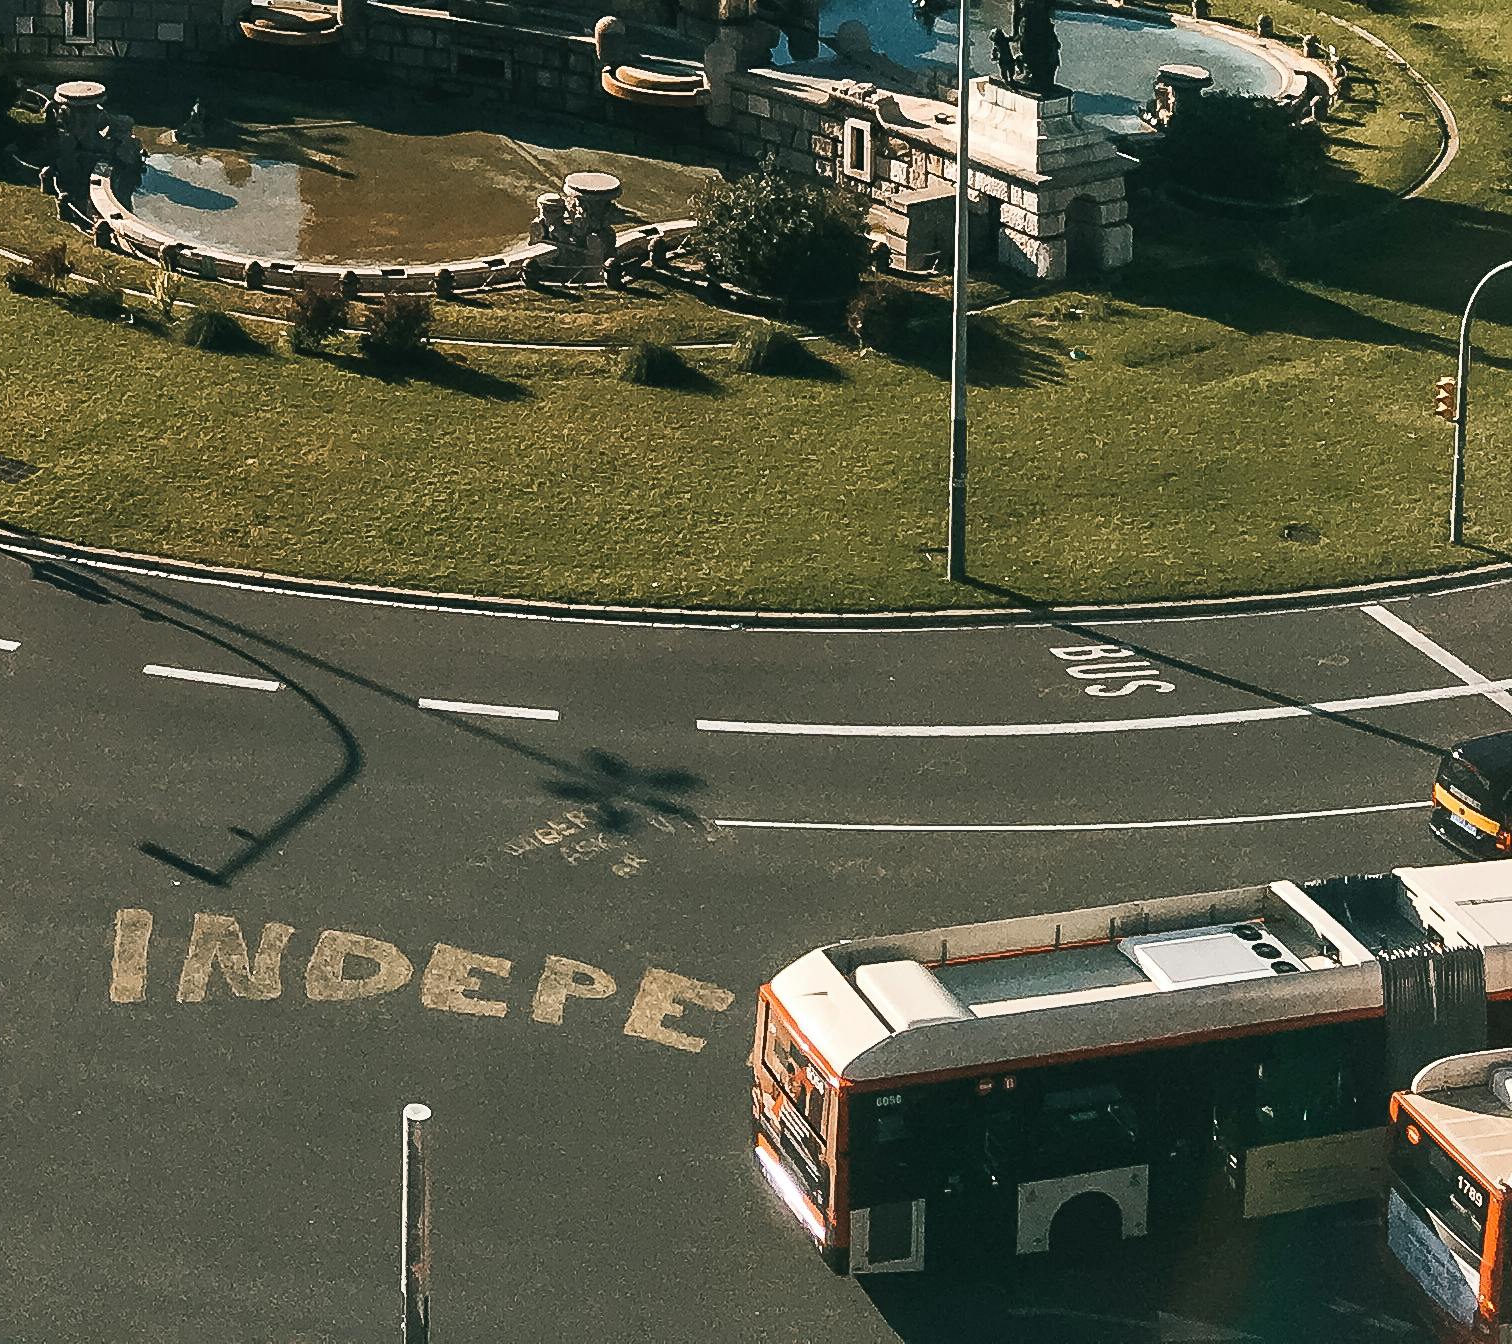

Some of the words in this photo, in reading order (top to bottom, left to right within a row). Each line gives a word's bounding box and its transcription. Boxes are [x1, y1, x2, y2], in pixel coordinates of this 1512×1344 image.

[1048, 644, 1176, 697] BUS
[109, 907, 736, 1053] INDEPE
[1457, 1174, 1483, 1209] 1789
